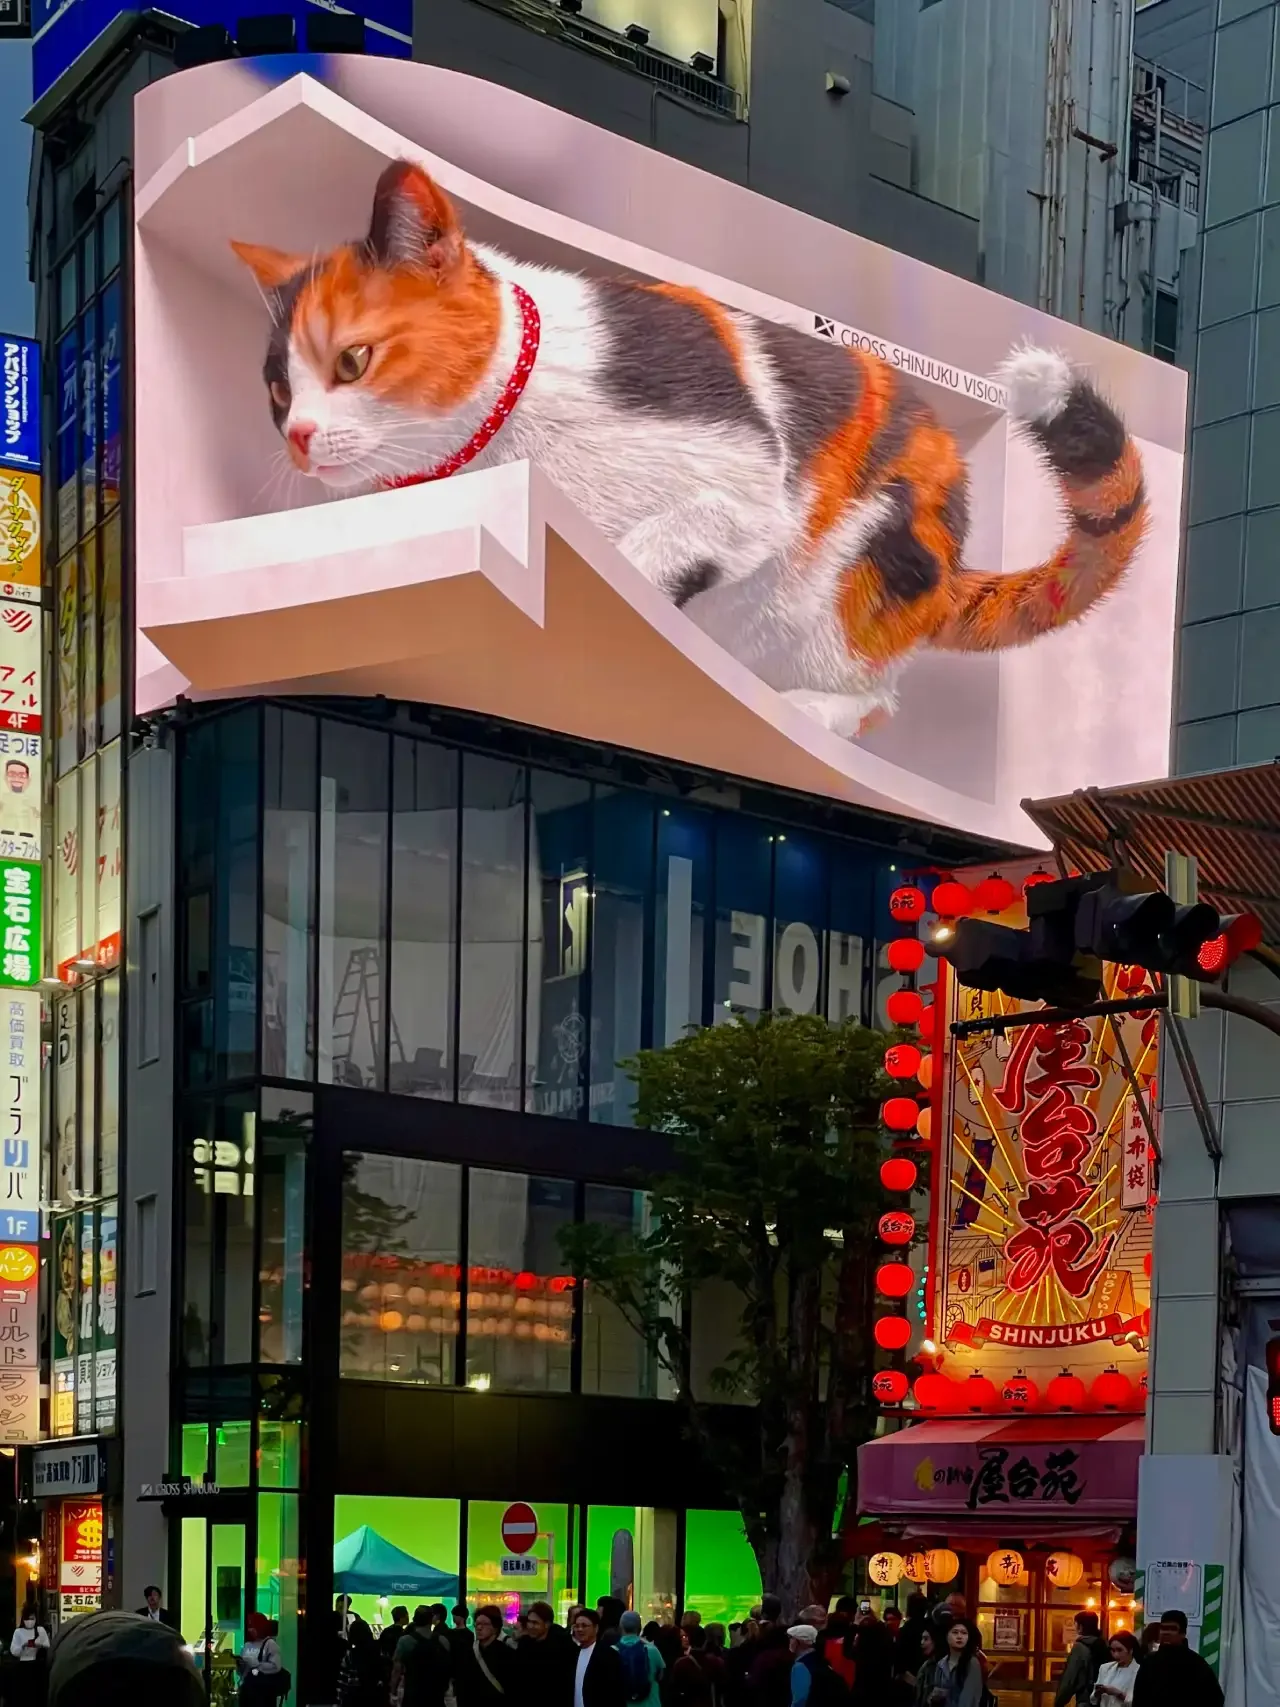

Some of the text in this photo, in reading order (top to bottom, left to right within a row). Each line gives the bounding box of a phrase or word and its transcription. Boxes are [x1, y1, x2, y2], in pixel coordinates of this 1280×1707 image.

[4, 343, 21, 444] アパマンショップ
[841, 329, 1008, 404] CROSS SHINJUKU VISION
[8, 476, 25, 562] ダーツグッズ
[7, 713, 28, 729] 4F
[3, 867, 31, 982] 宝石広場
[7, 1001, 28, 1200] 高価買取 ブラリバ
[7, 1216, 28, 1235] 1F
[0, 1289, 30, 1440] ゴールドラッシュ
[989, 1320, 1107, 1346] SHINJUKU
